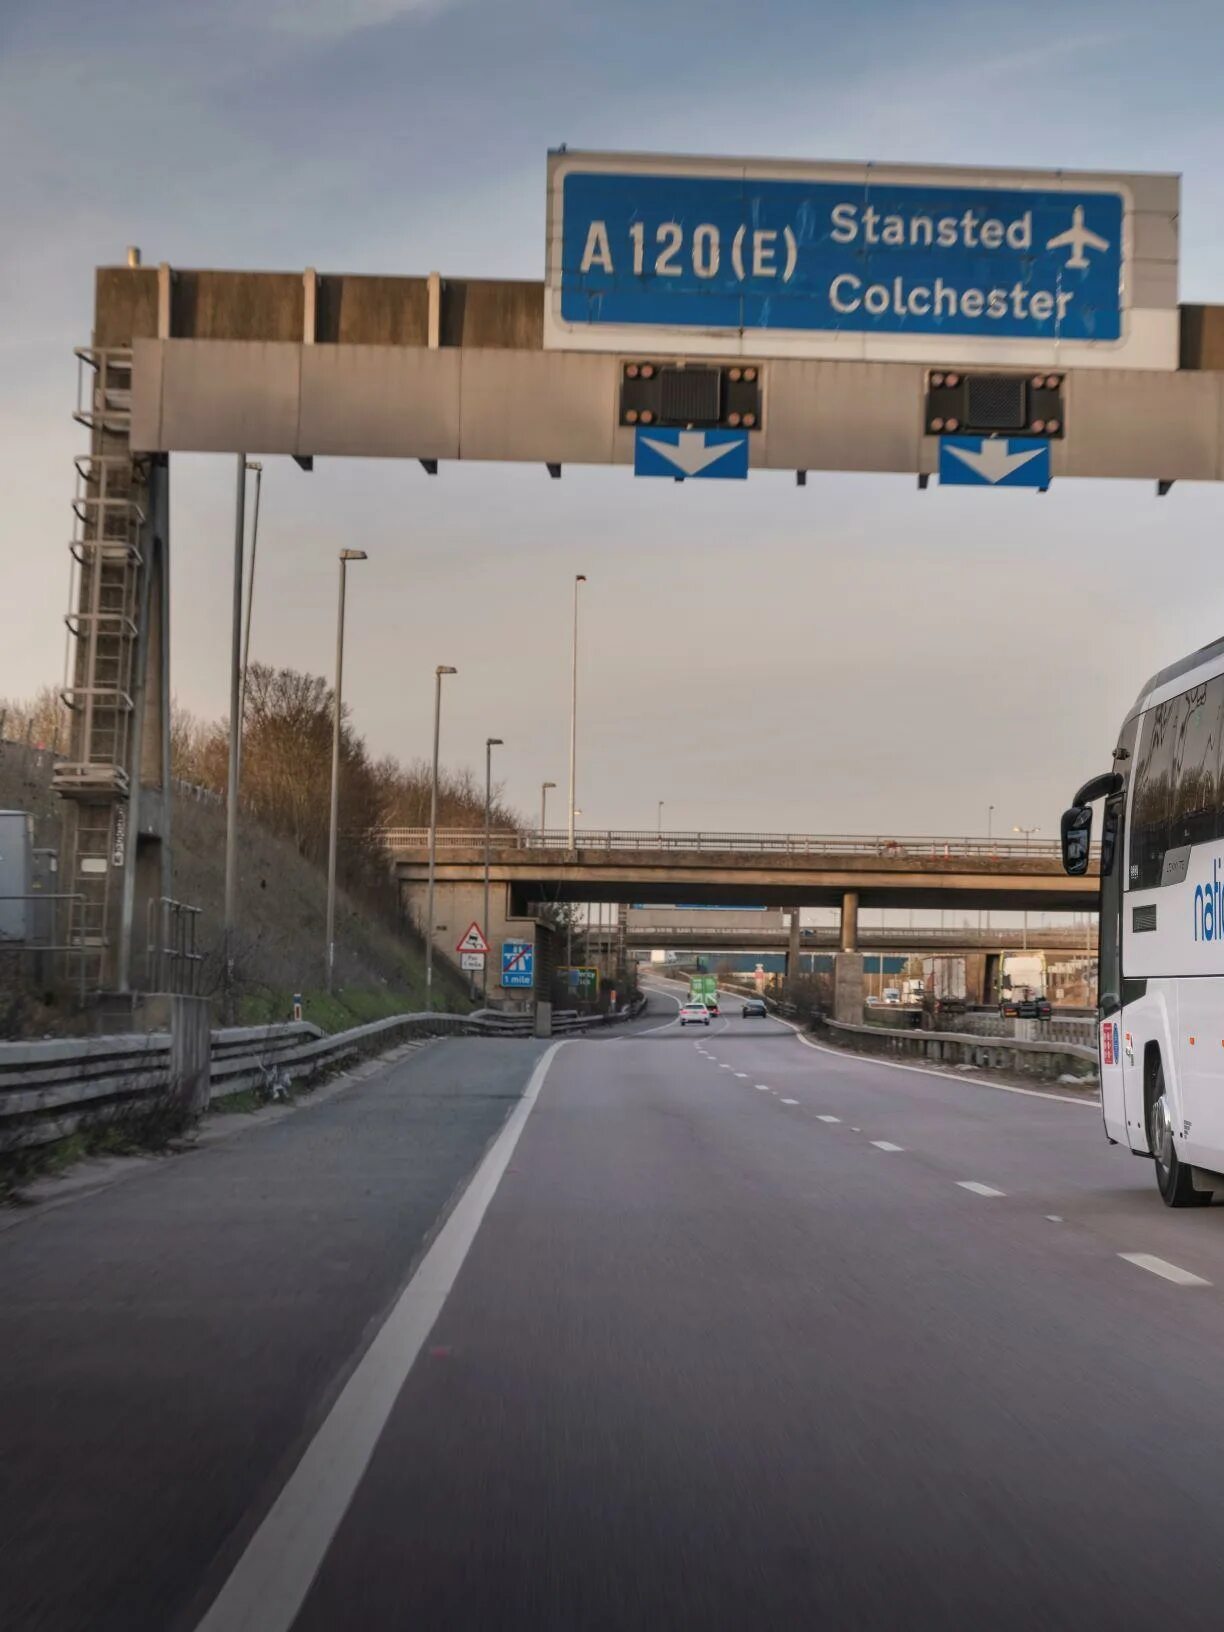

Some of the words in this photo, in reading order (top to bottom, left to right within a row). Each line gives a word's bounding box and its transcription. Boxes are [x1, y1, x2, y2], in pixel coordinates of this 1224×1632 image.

[829, 202, 1032, 250] Stansted
[829, 272, 1073, 320] Colchester
[511, 975, 530, 984] mile
